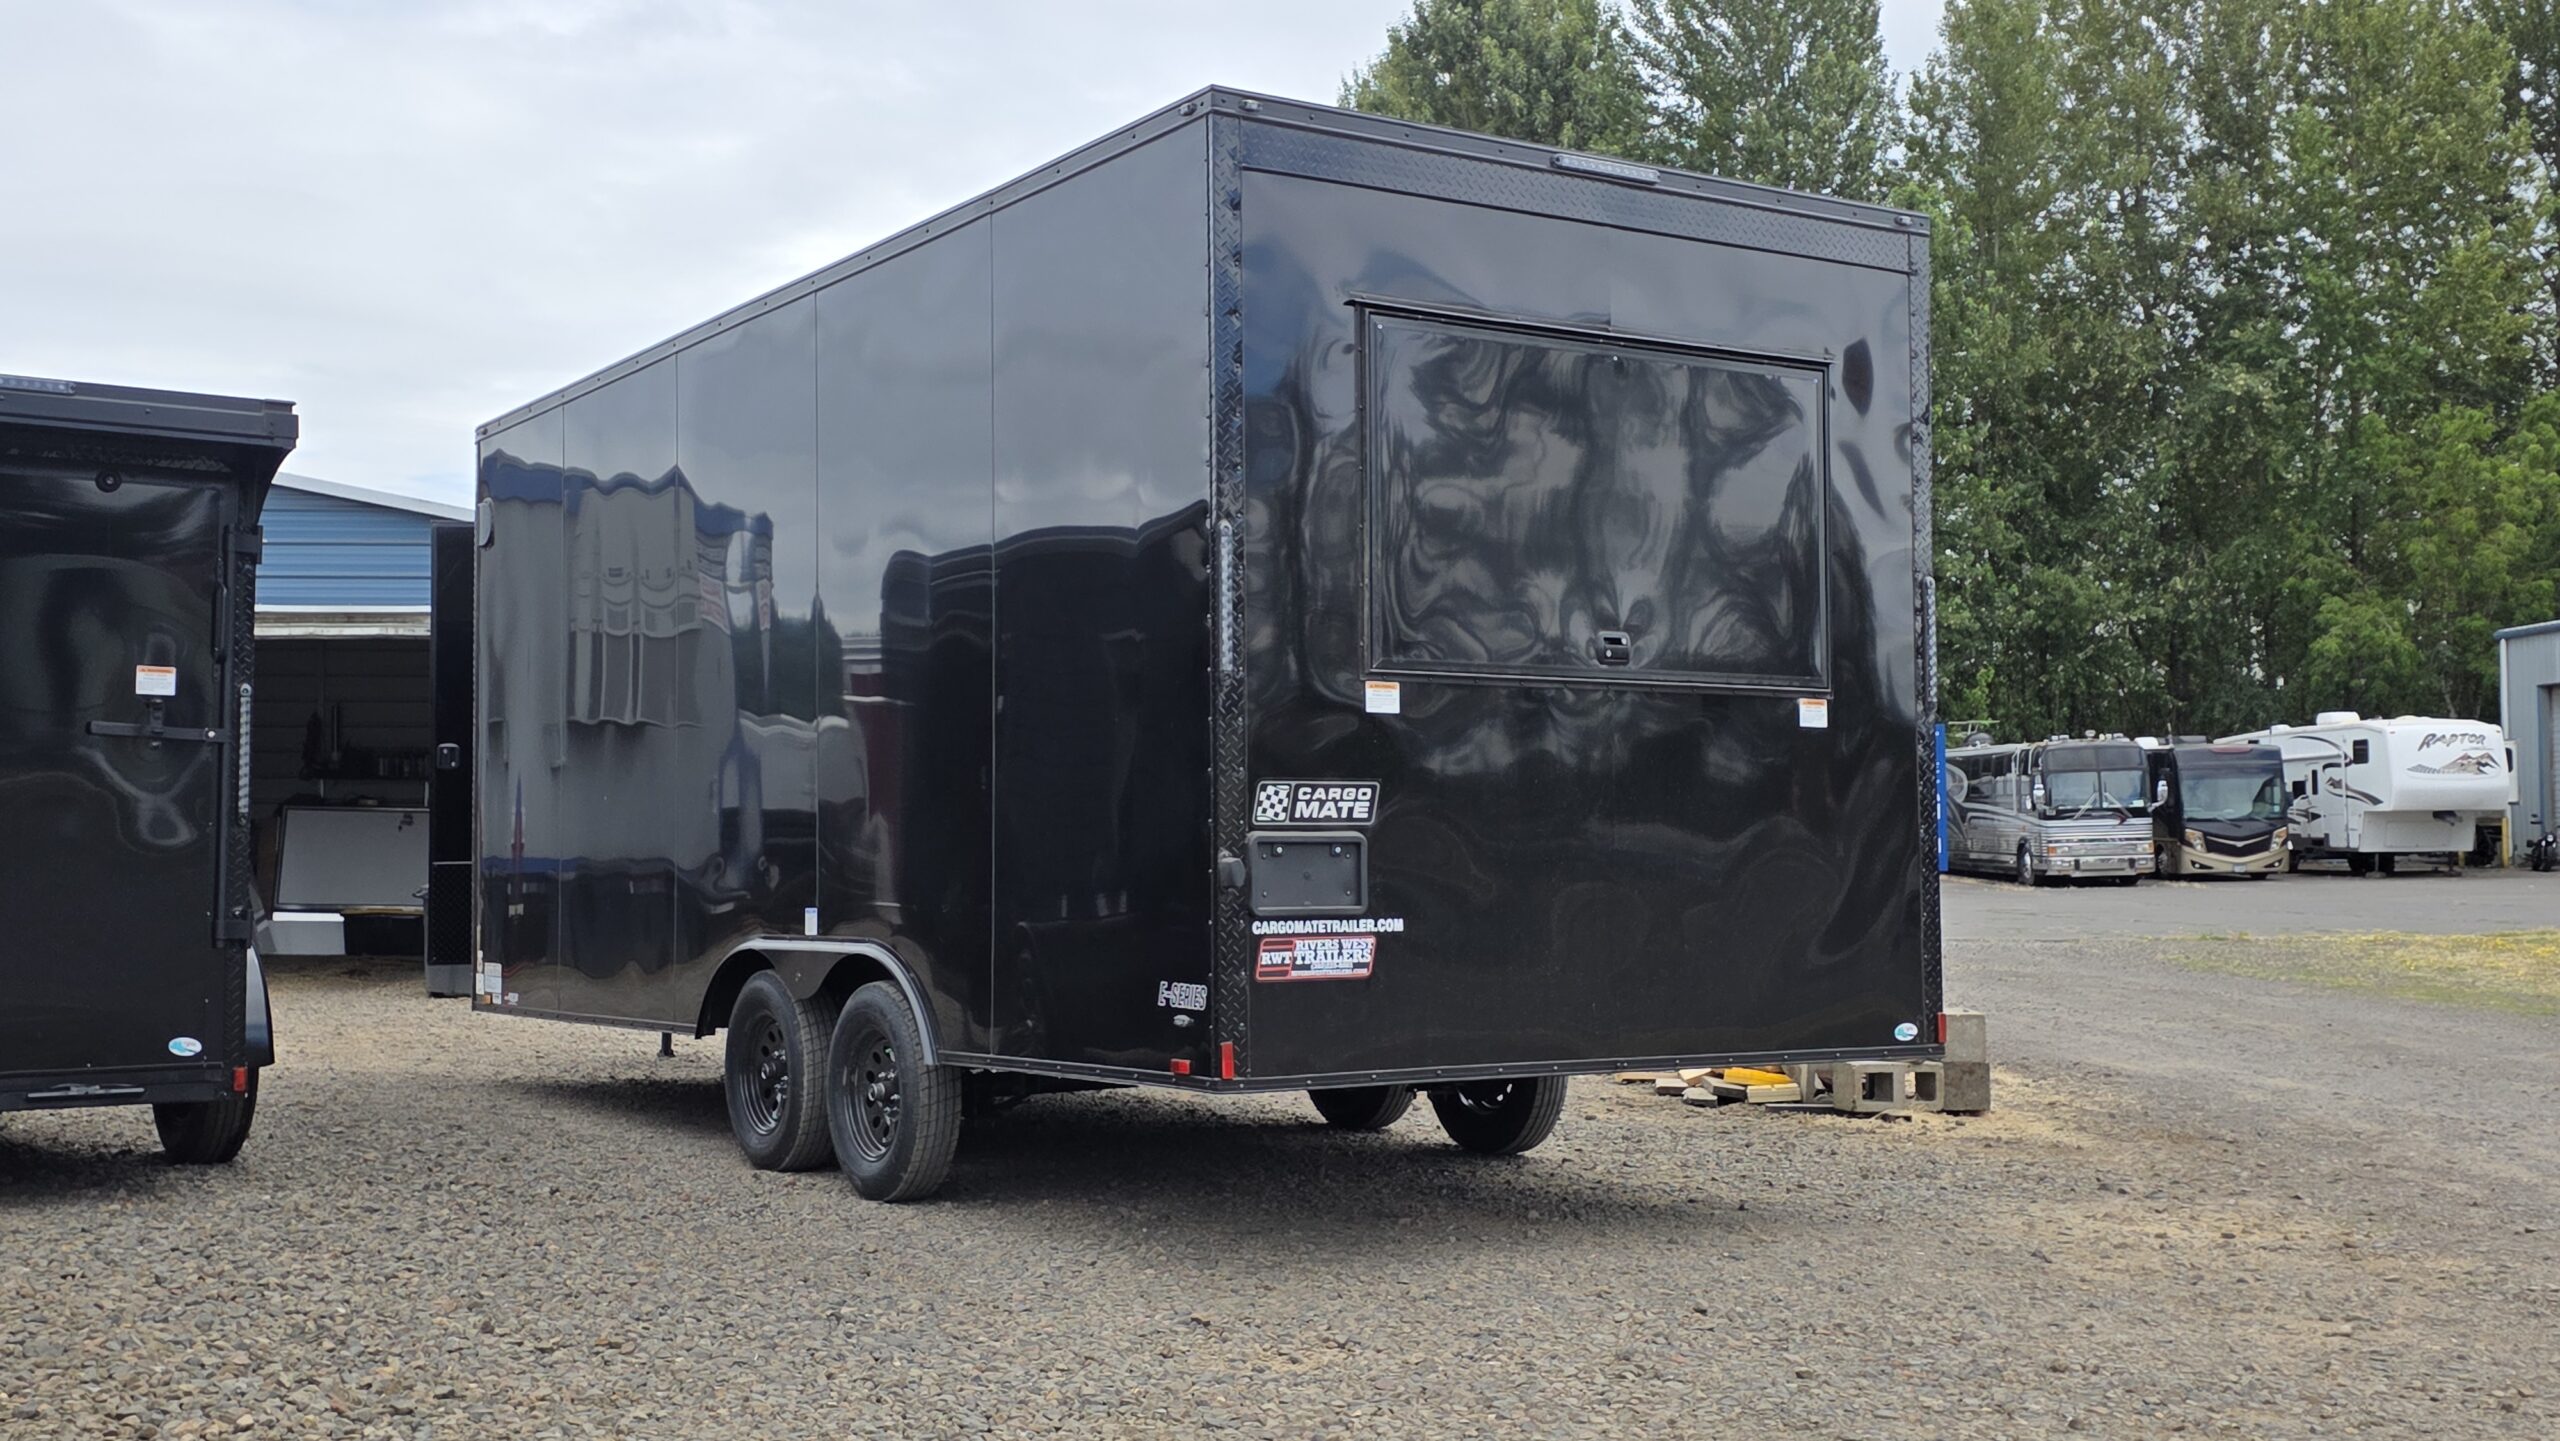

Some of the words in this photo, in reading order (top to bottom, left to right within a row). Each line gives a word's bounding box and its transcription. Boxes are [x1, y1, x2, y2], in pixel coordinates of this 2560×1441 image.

[2417, 732, 2487, 752] RAPTOR
[1297, 786, 1372, 800] CARGO
[1294, 800, 1370, 818] MATE
[1251, 918, 1404, 935] CARGOMATETRAILER.COM
[1295, 939, 1340, 950] RIVERS
[1341, 938, 1375, 949] WEST
[1260, 951, 1293, 965] RWT
[1293, 949, 1372, 964] TRAILERS
[1157, 980, 1208, 1011] E-SERIES
